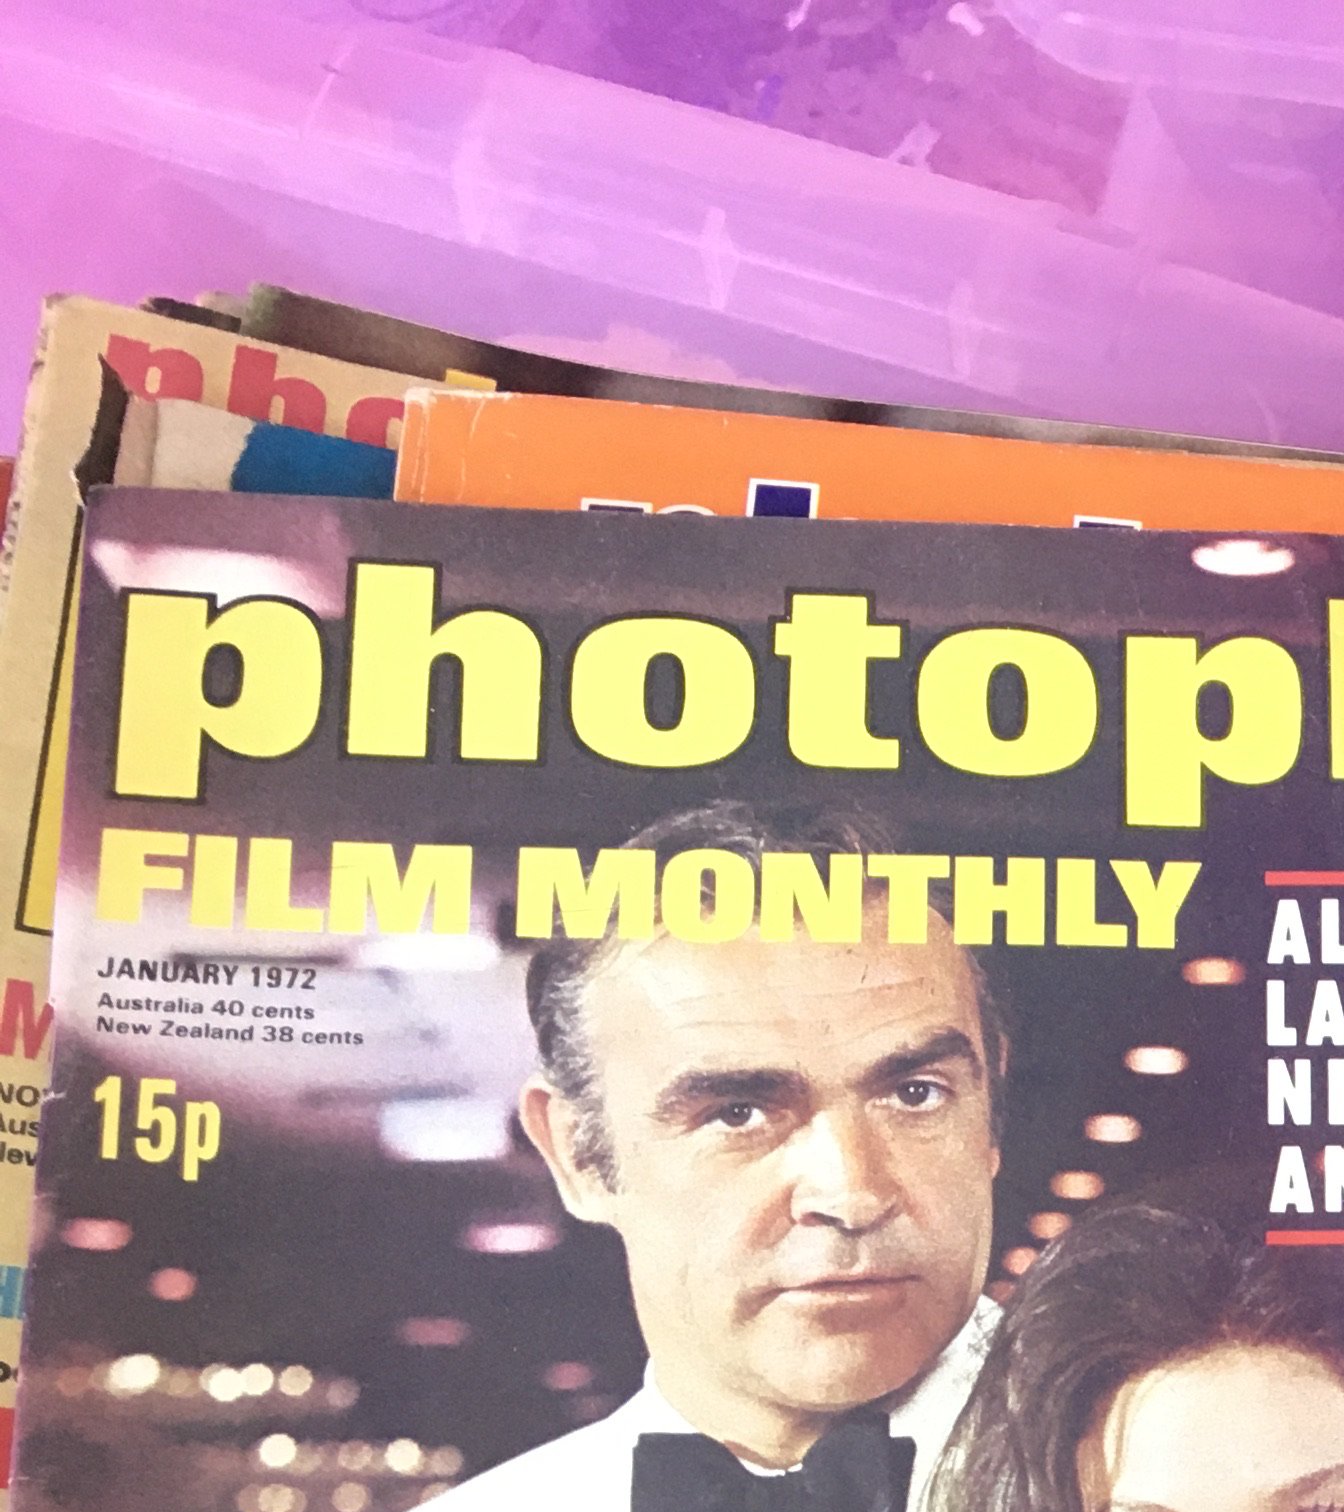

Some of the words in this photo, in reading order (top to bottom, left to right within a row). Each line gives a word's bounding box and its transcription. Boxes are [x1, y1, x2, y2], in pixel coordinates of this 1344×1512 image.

[96, 827, 475, 937] FILM
[514, 846, 1202, 950] MONTHLY
[97, 956, 240, 987] JANUARY
[251, 965, 318, 991] 1972
[97, 991, 205, 1015] Australia
[210, 999, 245, 1018] 40
[251, 1002, 316, 1021] cents
[95, 1015, 152, 1036] New
[158, 1019, 255, 1042] Zealand
[261, 1024, 295, 1044] 38
[301, 1029, 365, 1046] cents
[94, 1074, 222, 1182] 15p
